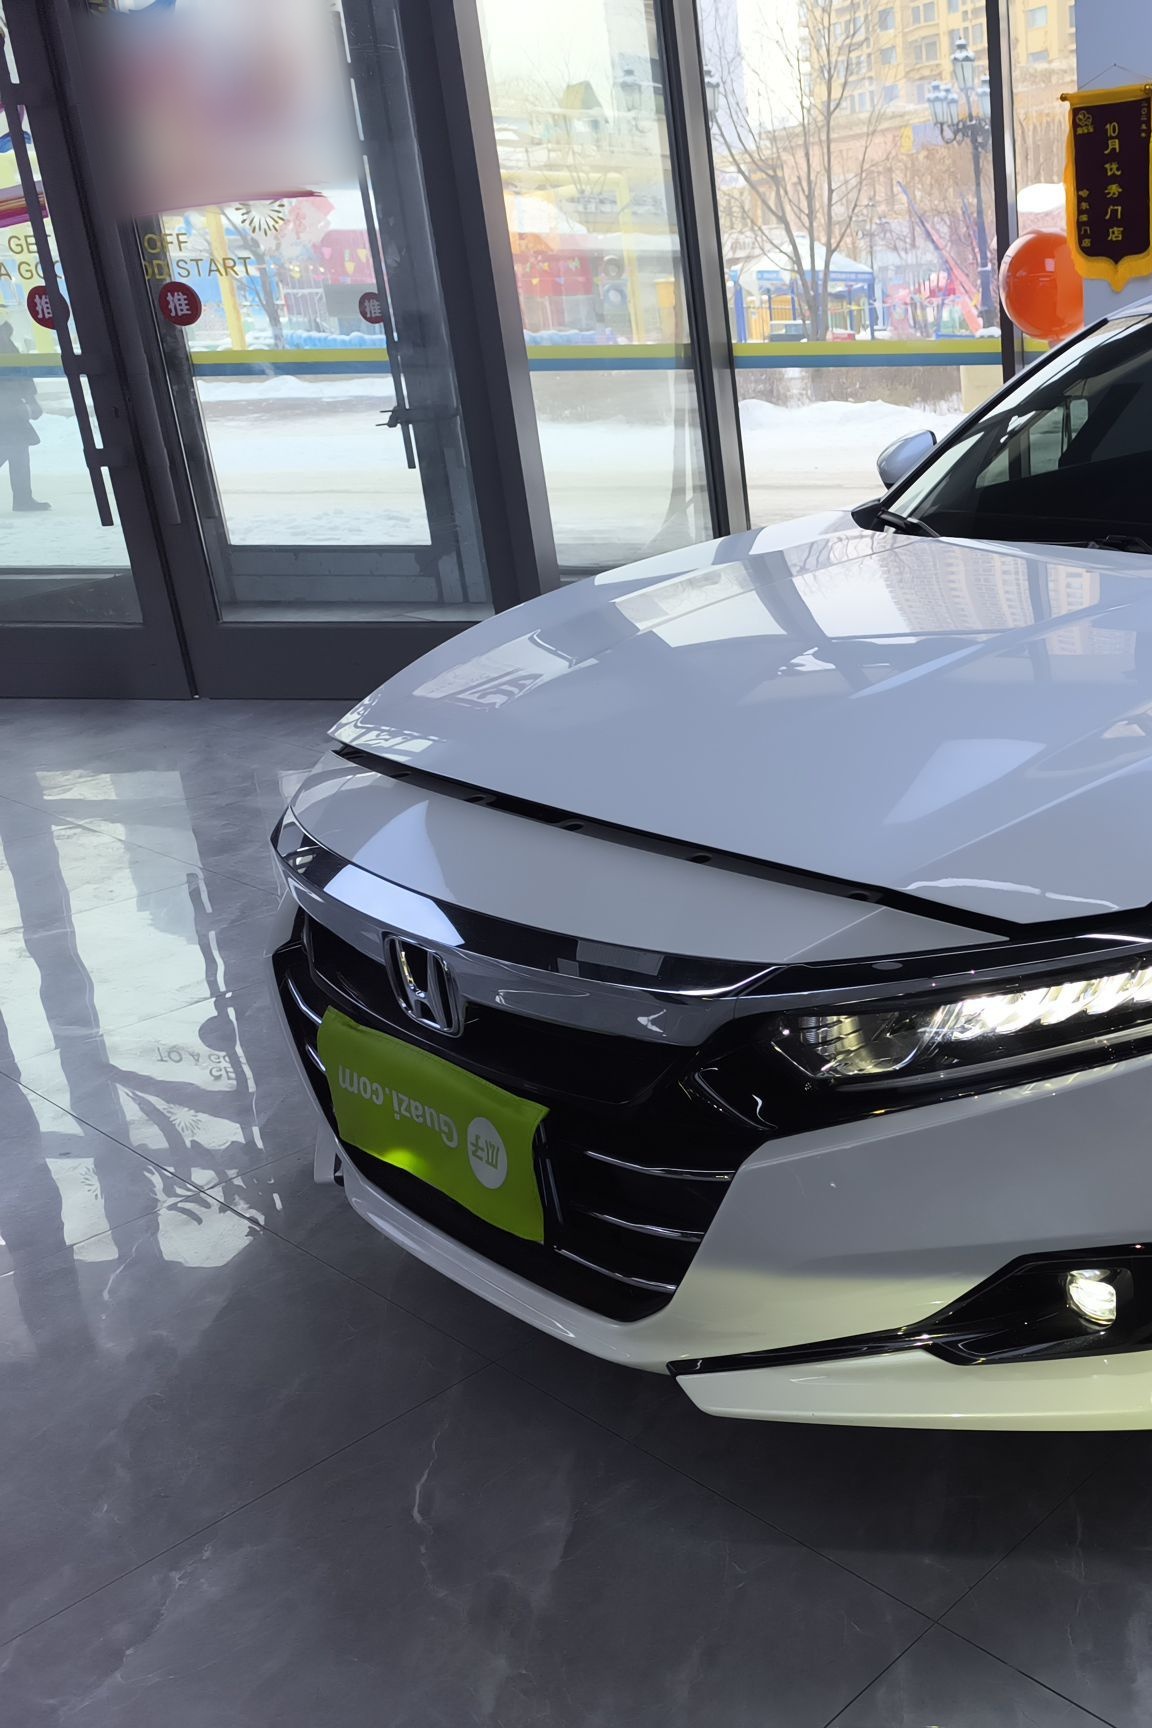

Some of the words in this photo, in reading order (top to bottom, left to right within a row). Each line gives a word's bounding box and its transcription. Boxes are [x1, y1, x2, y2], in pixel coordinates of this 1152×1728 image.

[143, 232, 189, 254] OFF
[176, 256, 252, 279] START
[166, 291, 192, 317] 推
[338, 1064, 459, 1149] Guazi.com
